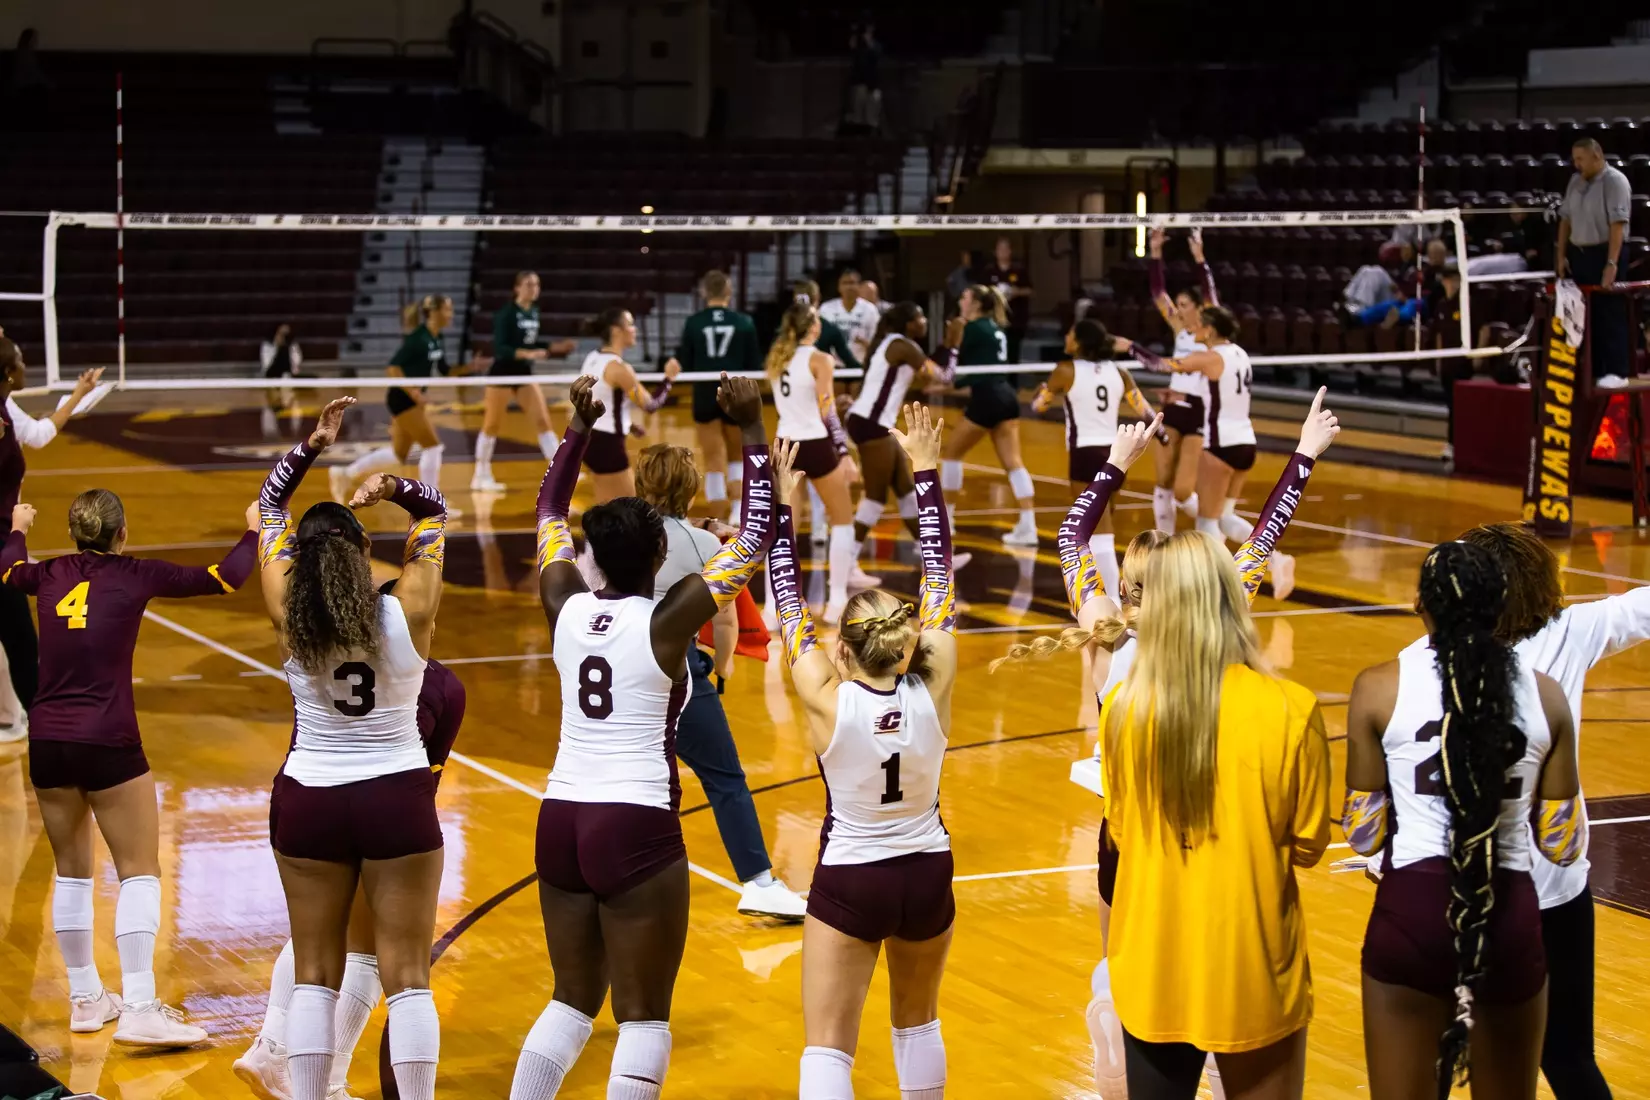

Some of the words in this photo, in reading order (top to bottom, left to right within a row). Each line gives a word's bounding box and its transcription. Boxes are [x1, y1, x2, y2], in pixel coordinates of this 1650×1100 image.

[702, 325, 735, 358] 17
[780, 371, 791, 397] 6
[1096, 385, 1109, 412] 9
[730, 479, 771, 563] CHIPPEWAS
[918, 506, 949, 594] CHIPPEWAS
[1058, 490, 1097, 575] CHIPPEWAS
[1247, 484, 1302, 563] CHIPPEWAS
[56, 581, 90, 629] 4
[770, 538, 803, 625] CHIPPEWAS
[333, 661, 376, 717] 3
[578, 655, 614, 720] 8
[881, 752, 903, 805] 1
